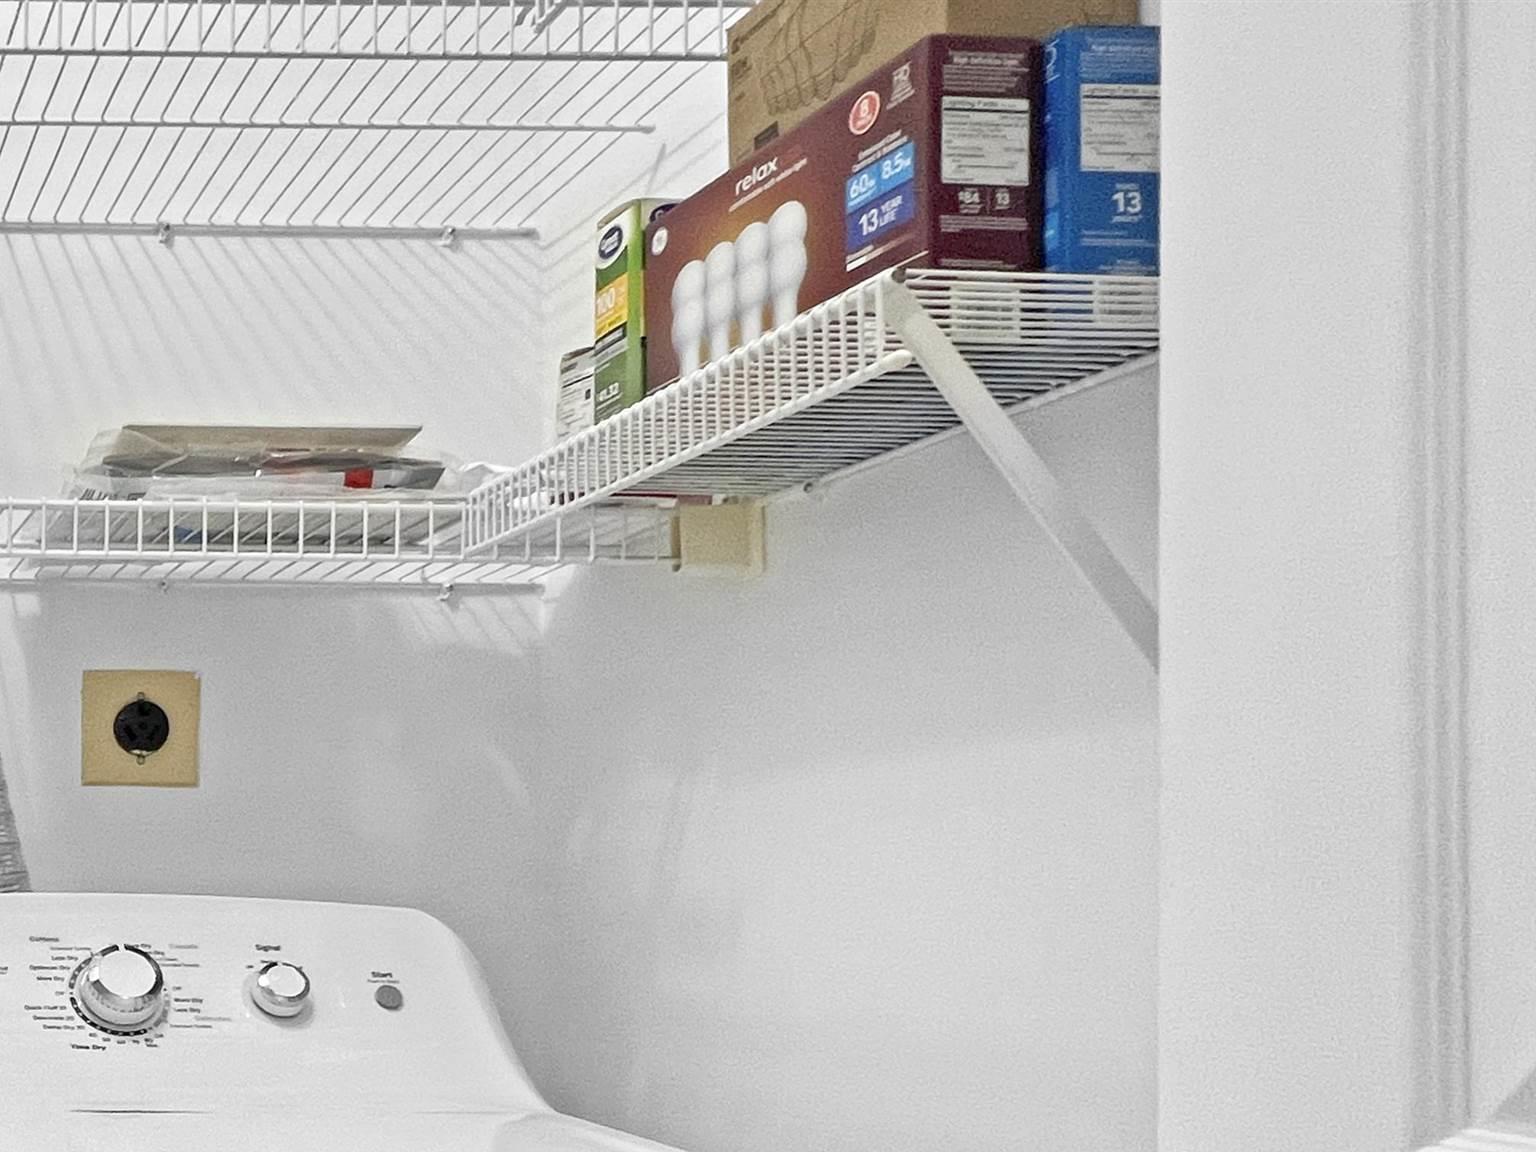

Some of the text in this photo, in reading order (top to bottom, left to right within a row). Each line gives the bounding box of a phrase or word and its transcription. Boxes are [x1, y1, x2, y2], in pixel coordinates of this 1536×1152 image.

[735, 157, 779, 196] relax
[1111, 191, 1142, 214] 13
[858, 208, 879, 236] 13
